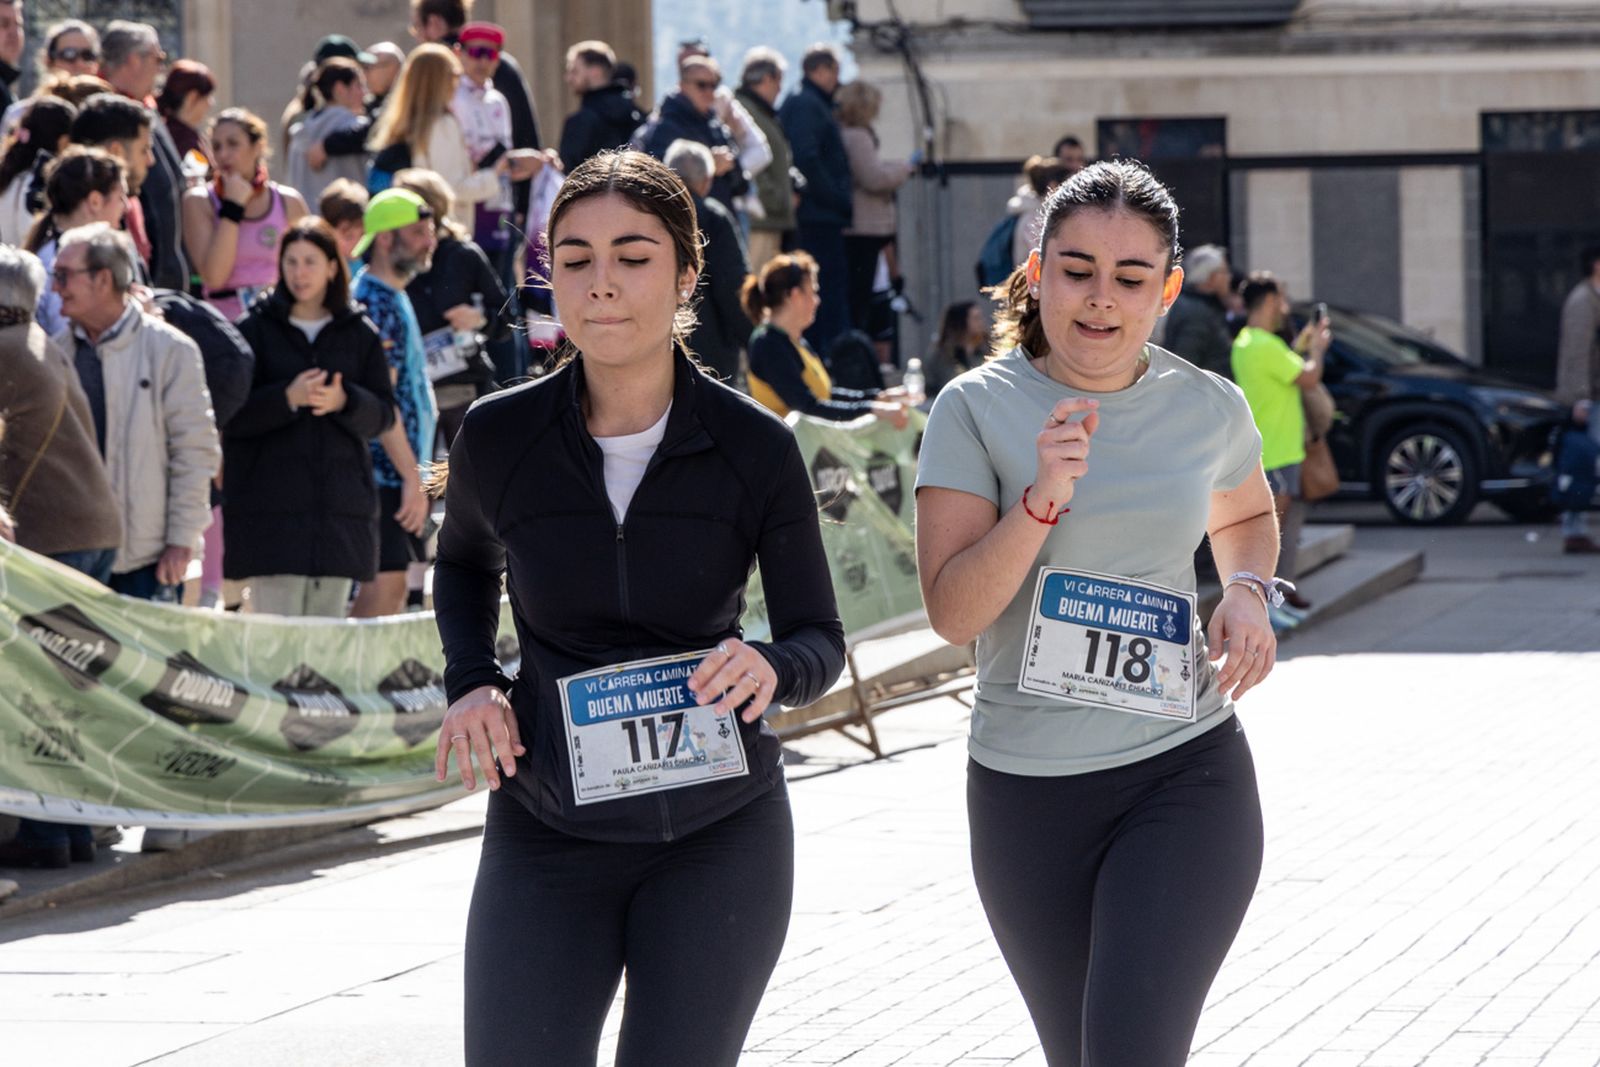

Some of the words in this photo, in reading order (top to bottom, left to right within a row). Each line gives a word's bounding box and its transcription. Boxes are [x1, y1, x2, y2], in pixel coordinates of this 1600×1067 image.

[1064, 579, 1075, 591] VI
[1078, 582, 1132, 602] CARRERA
[1134, 592, 1178, 613] CAMINATA
[1058, 597, 1104, 623] BUENA
[1108, 607, 1159, 633] MUERTE
[1085, 629, 1152, 683] 118
[585, 682, 597, 694] VI
[599, 672, 652, 692] CARRERA
[654, 664, 698, 682] CAMINAT
[1062, 672, 1086, 683] MARIA
[587, 692, 633, 719] BUENA
[637, 686, 685, 712] MUERTE
[621, 712, 685, 763] 117
[612, 766, 636, 776] PAULA
